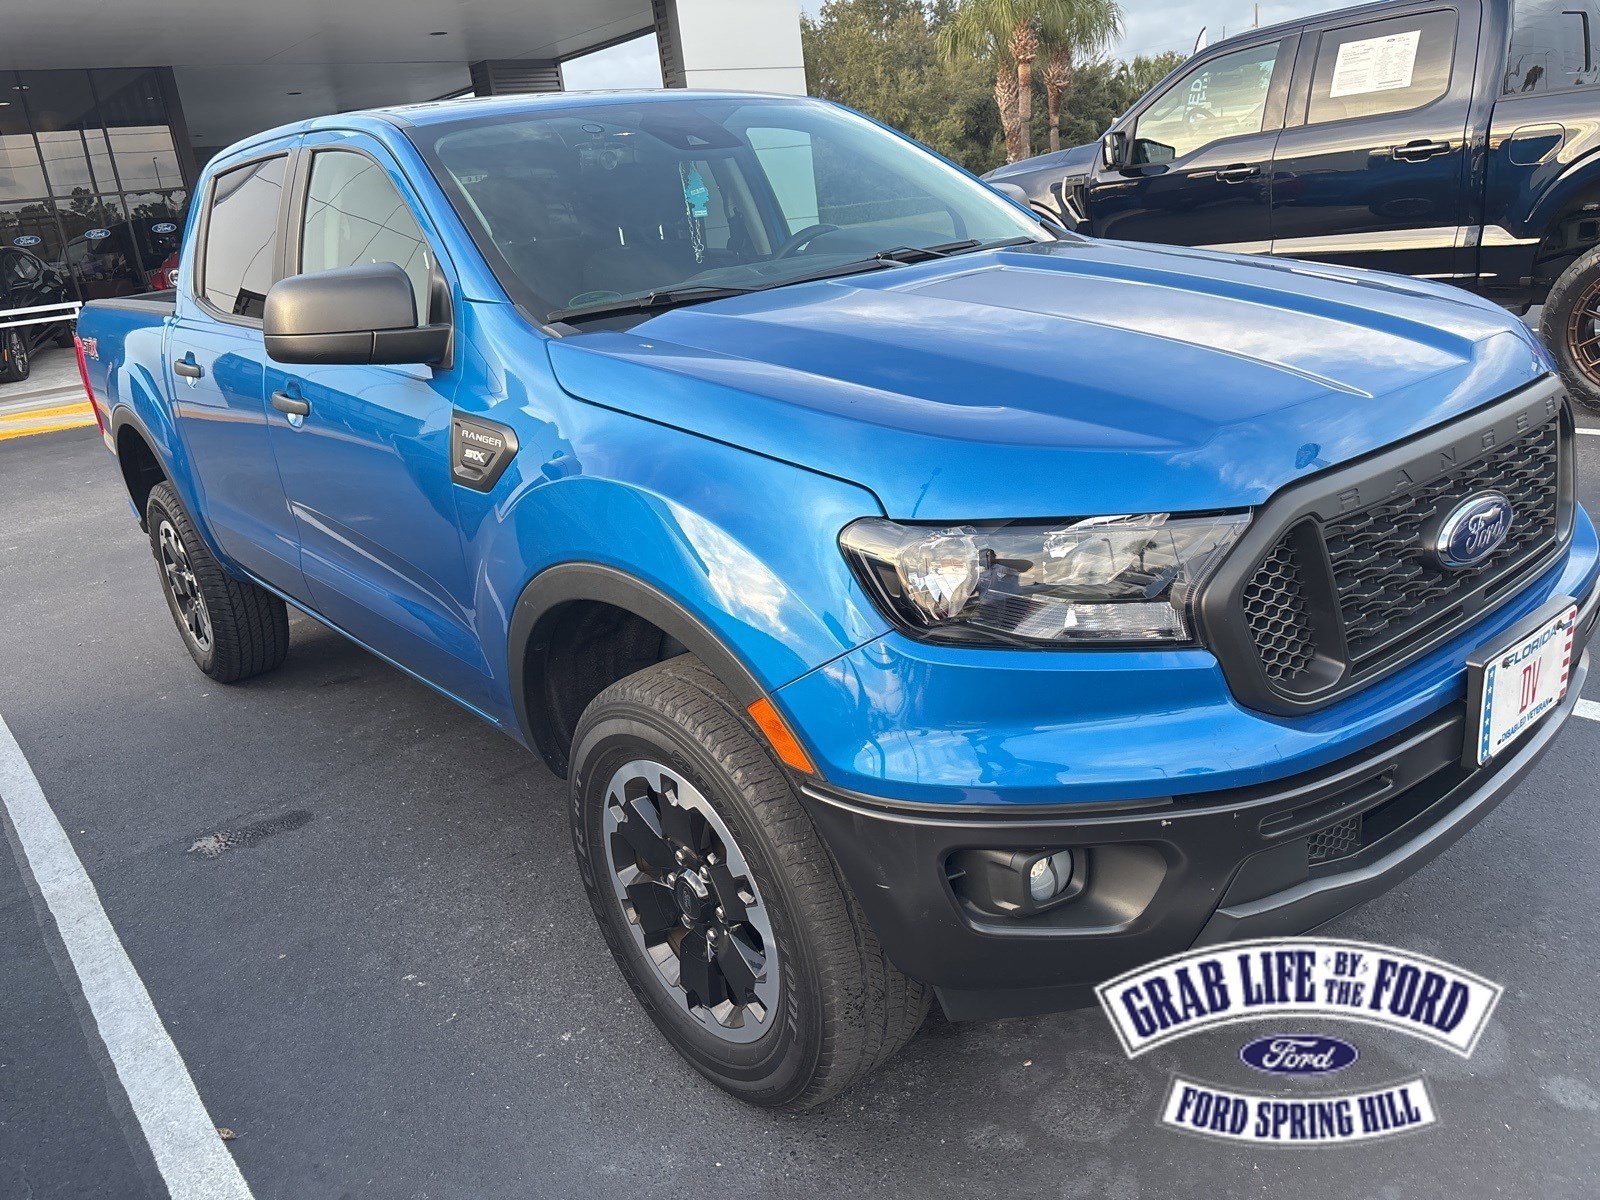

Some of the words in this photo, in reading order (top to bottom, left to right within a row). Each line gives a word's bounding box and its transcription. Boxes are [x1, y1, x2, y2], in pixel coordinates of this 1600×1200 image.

[461, 429, 502, 447] RANGER
[463, 448, 486, 463] STX
[1335, 396, 1557, 514] RANGER
[1465, 506, 1505, 555] Ford
[1507, 625, 1557, 667] FLORIDA
[1519, 655, 1542, 714] DV
[1501, 714, 1527, 742] DISABLED
[1525, 698, 1551, 722] VETERAN
